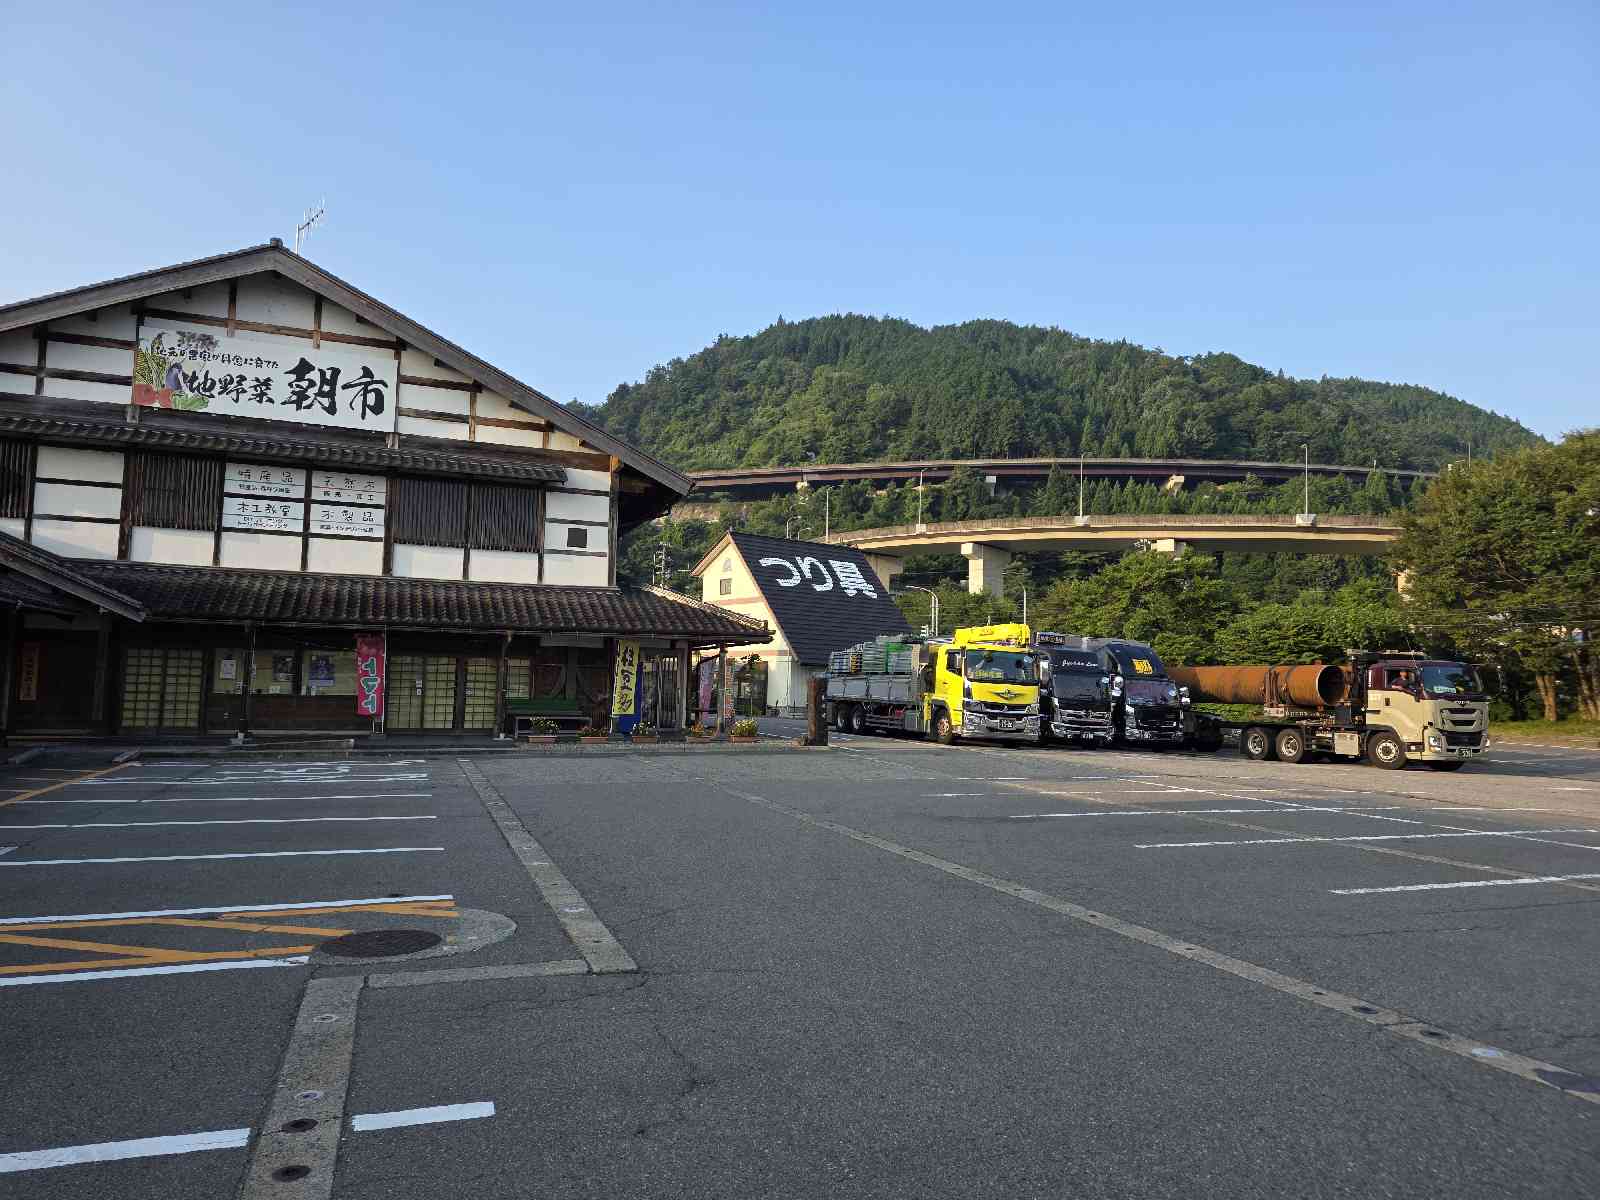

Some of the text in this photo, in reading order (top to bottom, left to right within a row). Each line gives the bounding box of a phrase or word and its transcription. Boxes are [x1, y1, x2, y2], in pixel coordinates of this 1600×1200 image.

[184, 357, 389, 420] 地野菜 朝市
[237, 500, 291, 516] 木工教室
[758, 554, 878, 599] つり具
[360, 656, 380, 713] トマト
